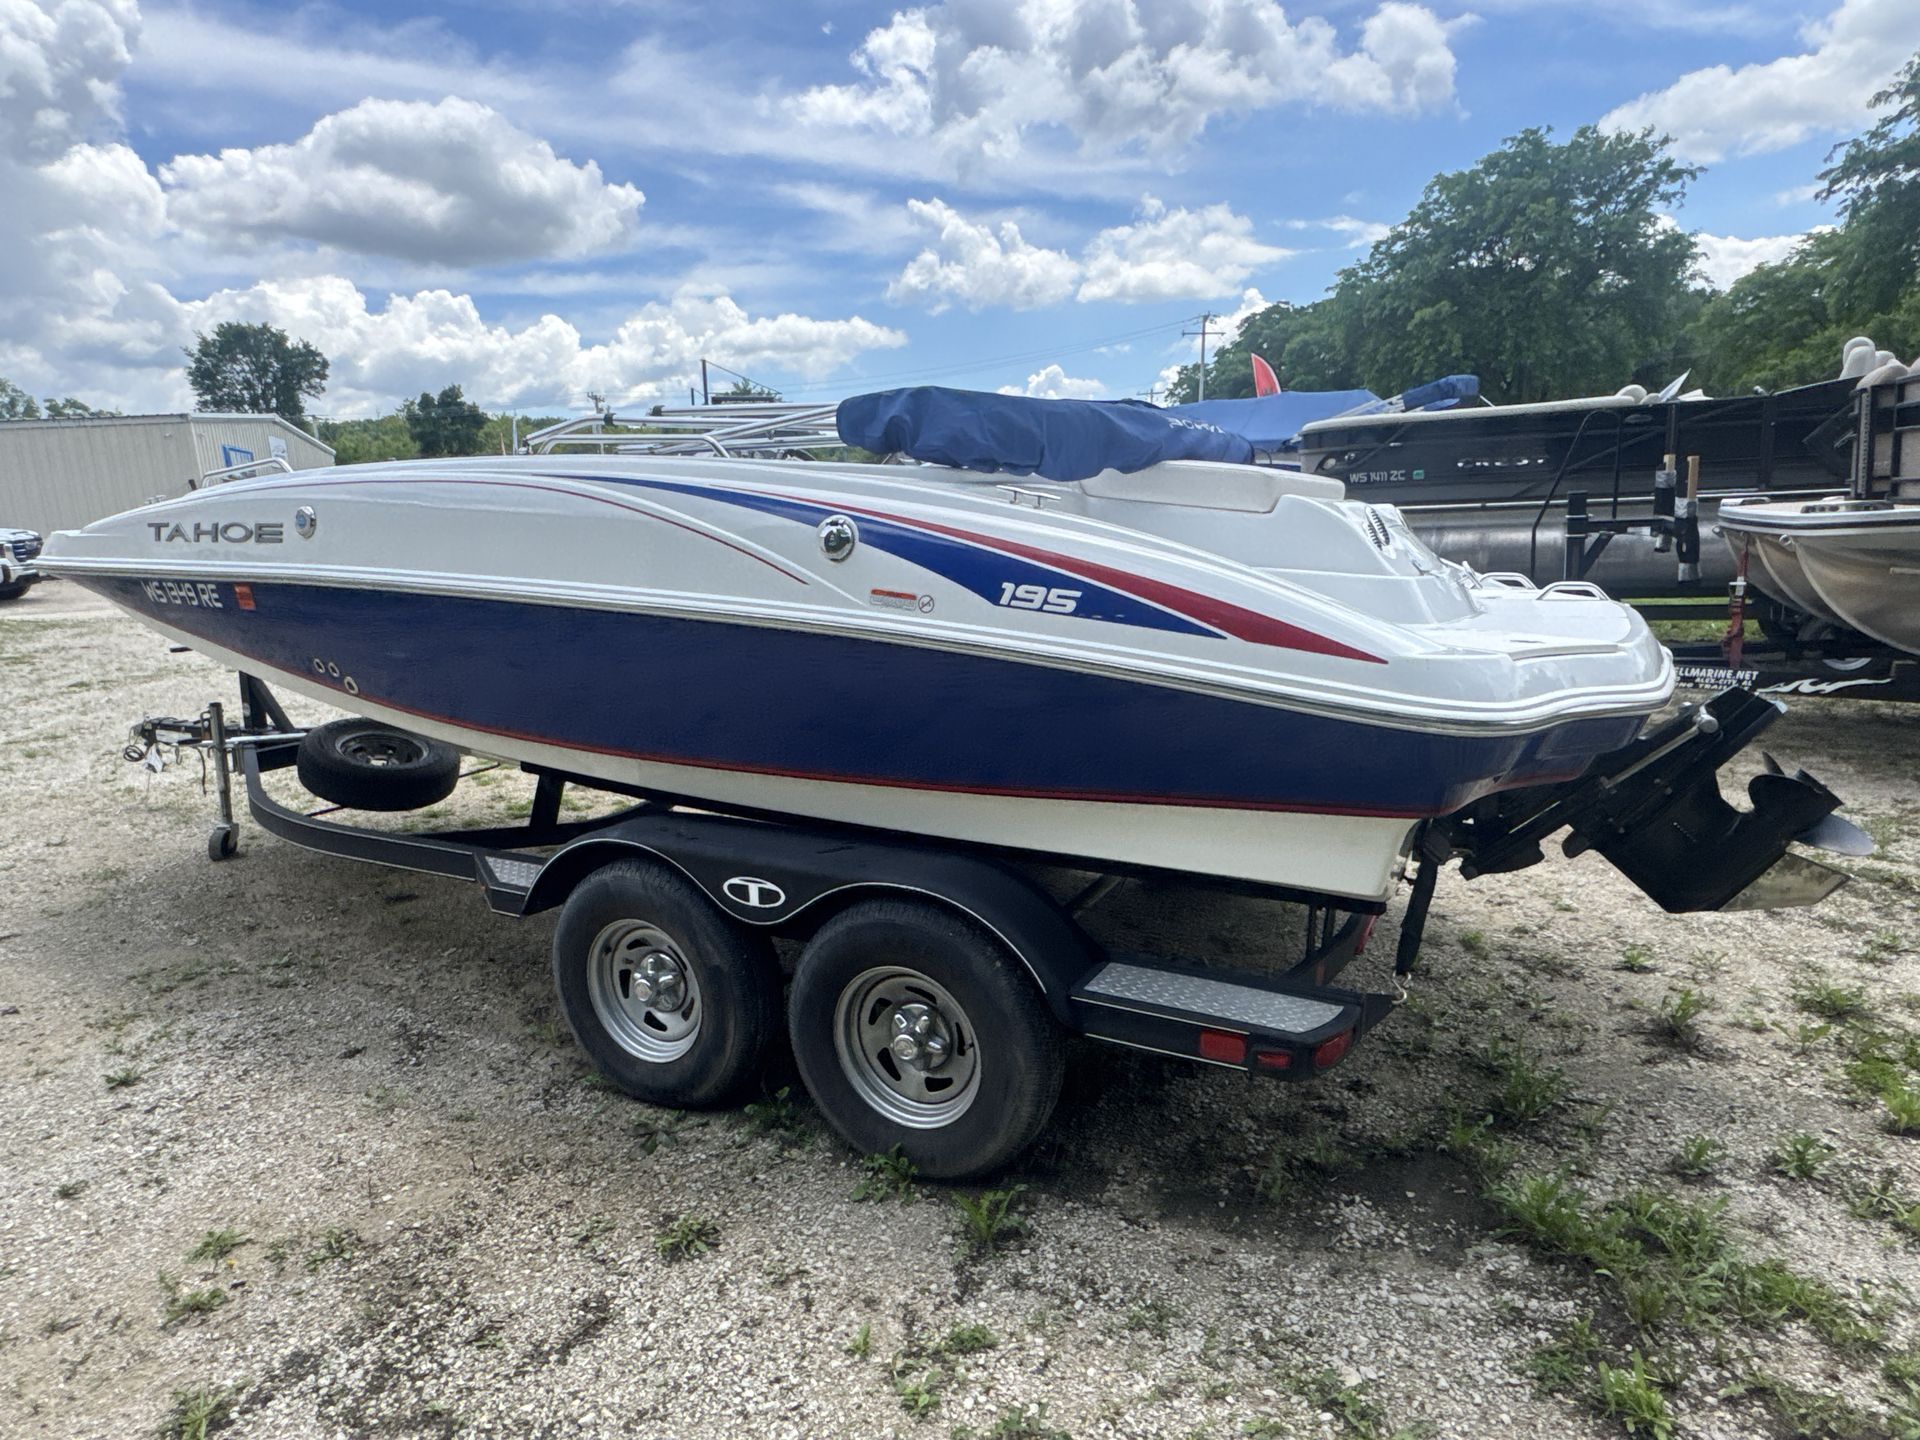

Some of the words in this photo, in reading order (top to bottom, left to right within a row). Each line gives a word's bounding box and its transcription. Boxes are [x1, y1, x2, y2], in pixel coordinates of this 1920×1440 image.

[1350, 472, 1368, 483] WS
[1390, 470, 1406, 481] ZC
[147, 522, 283, 543] TAHOE
[142, 580, 167, 603] WS
[164, 581, 198, 606] 1349
[197, 583, 224, 608] RE
[1000, 582, 1083, 614] 195
